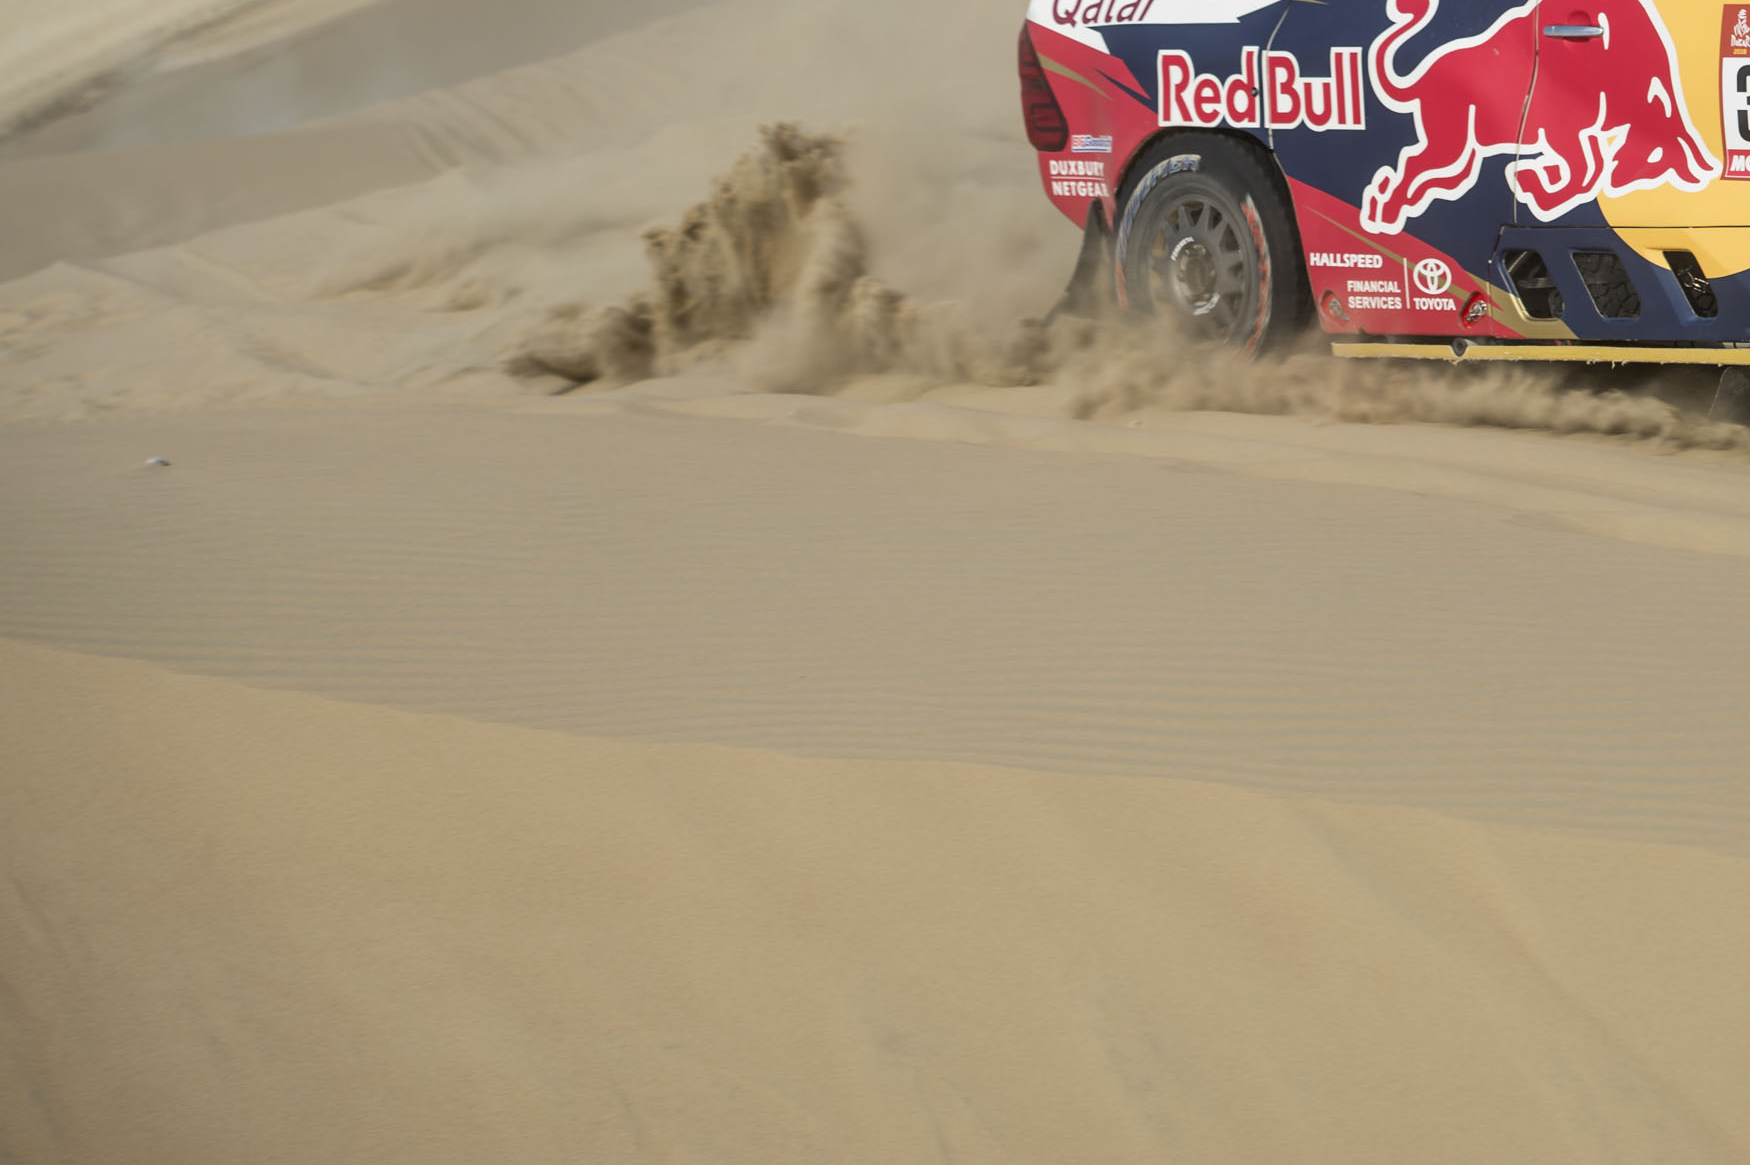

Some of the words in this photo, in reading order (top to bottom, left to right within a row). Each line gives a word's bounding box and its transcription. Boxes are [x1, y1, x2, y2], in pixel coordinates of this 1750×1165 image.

[1158, 47, 1259, 126] Red
[1264, 48, 1364, 130] Bull
[1050, 160, 1105, 176] DUXBURY
[1052, 181, 1110, 197] NETGEAR
[1309, 252, 1383, 268] HALLSPEED
[1347, 280, 1401, 293] FINANCIAL
[1348, 296, 1402, 309] SERVICES
[1413, 297, 1456, 311] TOYOTA
